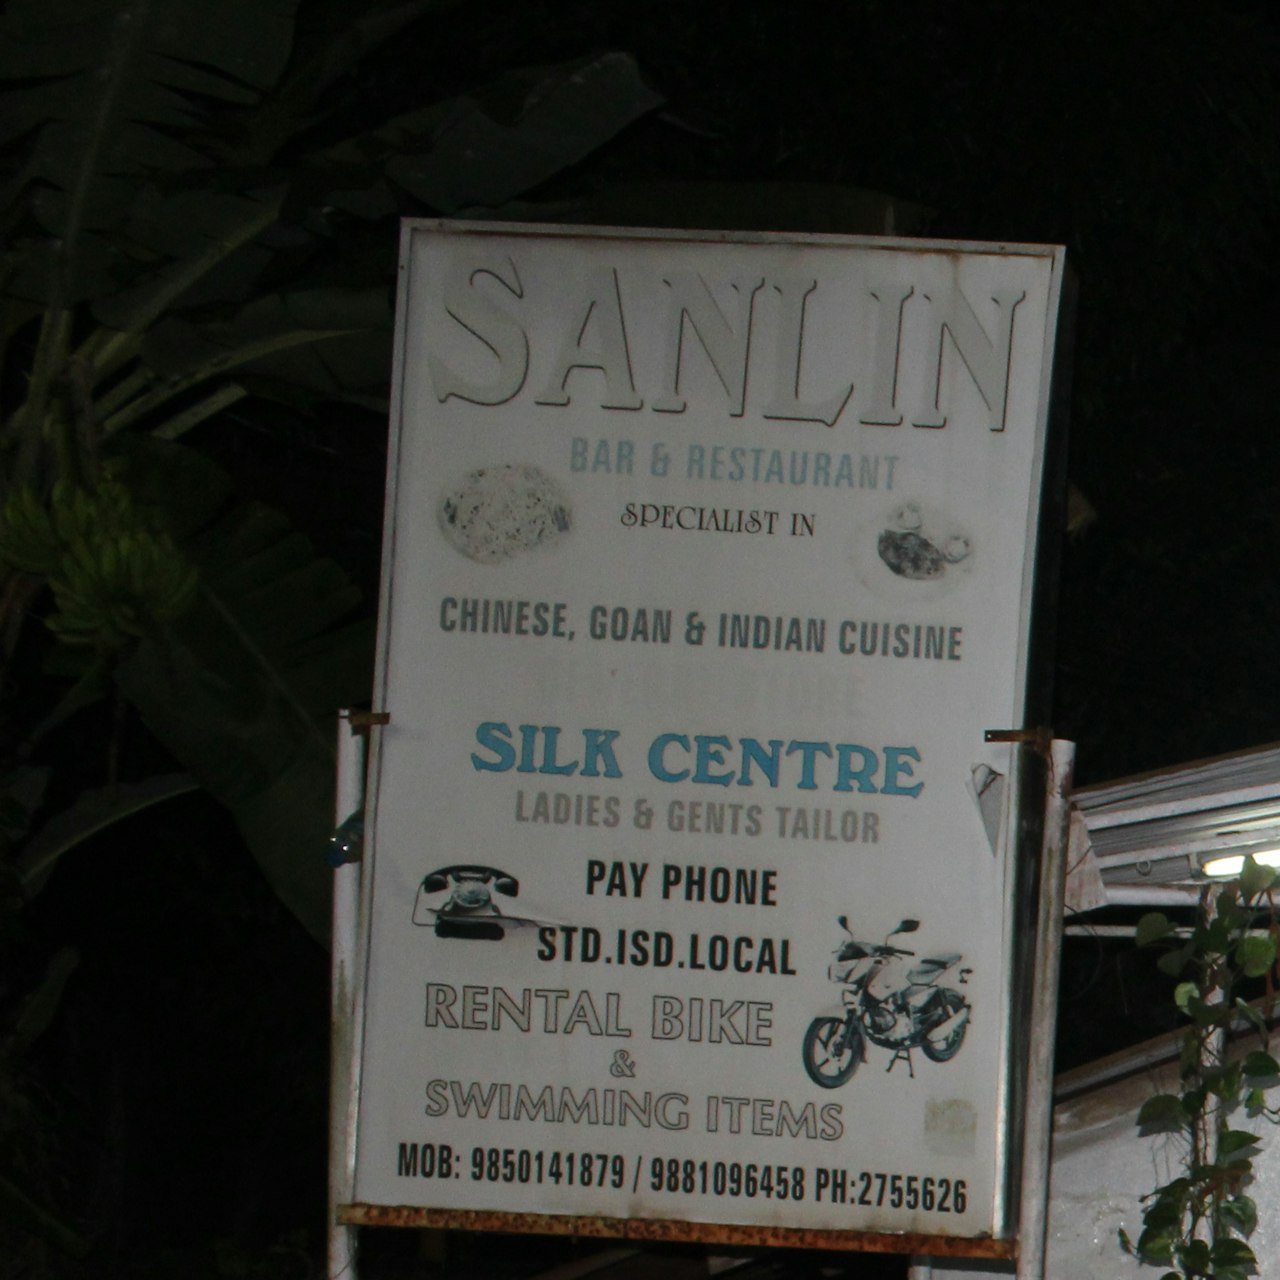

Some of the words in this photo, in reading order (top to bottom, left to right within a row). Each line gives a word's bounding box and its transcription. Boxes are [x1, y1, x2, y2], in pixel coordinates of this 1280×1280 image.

[428, 257, 1027, 433] SANLIN
[569, 436, 636, 477] BAR
[650, 441, 672, 479] &
[685, 440, 900, 491] RESTAURANT
[620, 503, 780, 536] SPECIALIST
[790, 513, 816, 538] IN
[439, 596, 576, 642] CHINESE,
[588, 604, 672, 645] GOAN
[684, 610, 707, 646] &
[717, 612, 827, 655] INDIAN
[837, 620, 963, 661] CUISINE
[469, 720, 624, 779] SILK
[646, 731, 926, 799] CENTRE
[513, 789, 621, 828] LADIES
[632, 797, 655, 831] &
[665, 800, 764, 837] GENTS
[774, 806, 881, 844] TAILOR
[585, 858, 649, 899] PAY
[661, 863, 778, 907] PHONE
[536, 926, 797, 976] STD.ISD.LOCAL
[423, 981, 633, 1040] RENTAL
[650, 994, 774, 1047] BIKE
[608, 1048, 637, 1079] &
[423, 1078, 691, 1132] SWIMMING
[704, 1094, 845, 1142] ITEMS
[397, 1142, 462, 1181] MOB:
[470, 1146, 626, 1190] 9850141879
[631, 1154, 644, 1195] /
[650, 1156, 806, 1201] 9881096458
[814, 1167, 968, 1215] PH:2755626
